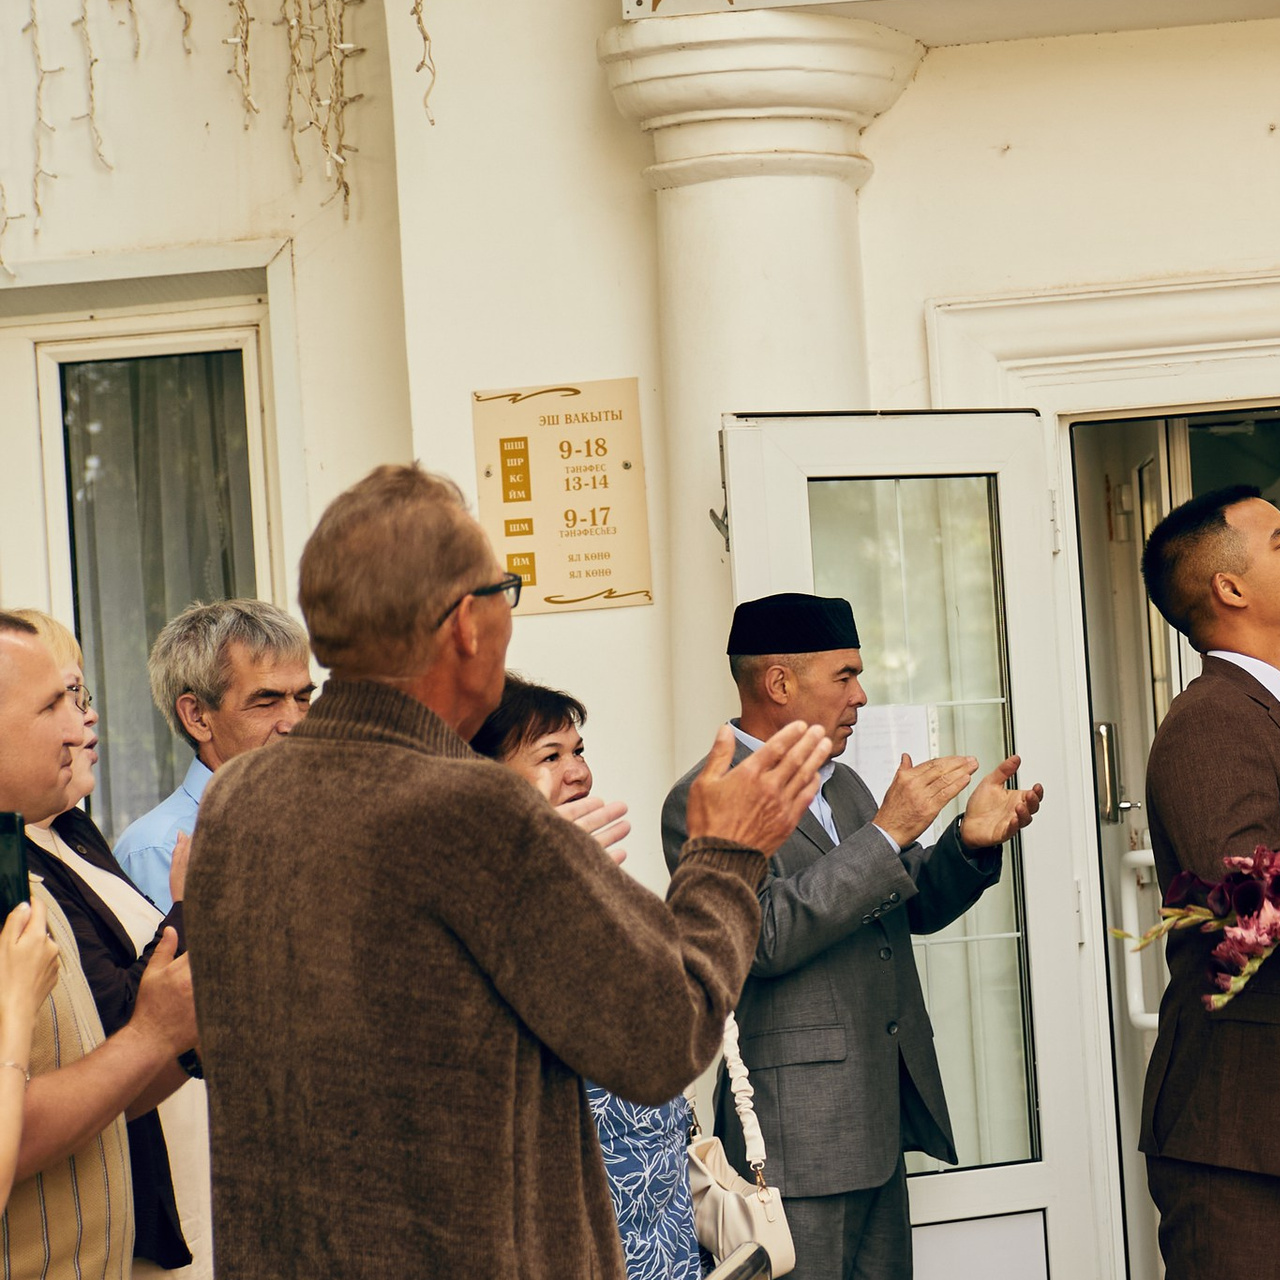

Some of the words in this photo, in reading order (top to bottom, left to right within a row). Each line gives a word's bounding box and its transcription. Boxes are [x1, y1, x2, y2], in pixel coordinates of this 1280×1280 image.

[539, 414, 559, 426] ЭШ
[504, 441, 525, 451] ШШ
[559, 437, 608, 460] 9-18
[506, 458, 524, 467] ШР
[509, 474, 524, 483] КС
[565, 474, 609, 491] 13-14
[509, 489, 526, 500] ЙМ
[563, 507, 611, 529] 9-17
[509, 523, 529, 532] ШМ
[568, 554, 581, 563] ЯЛ
[584, 552, 611, 562] КӨНӨ
[569, 570, 582, 579] ЯЛ
[585, 568, 612, 578] КӨНӨ
